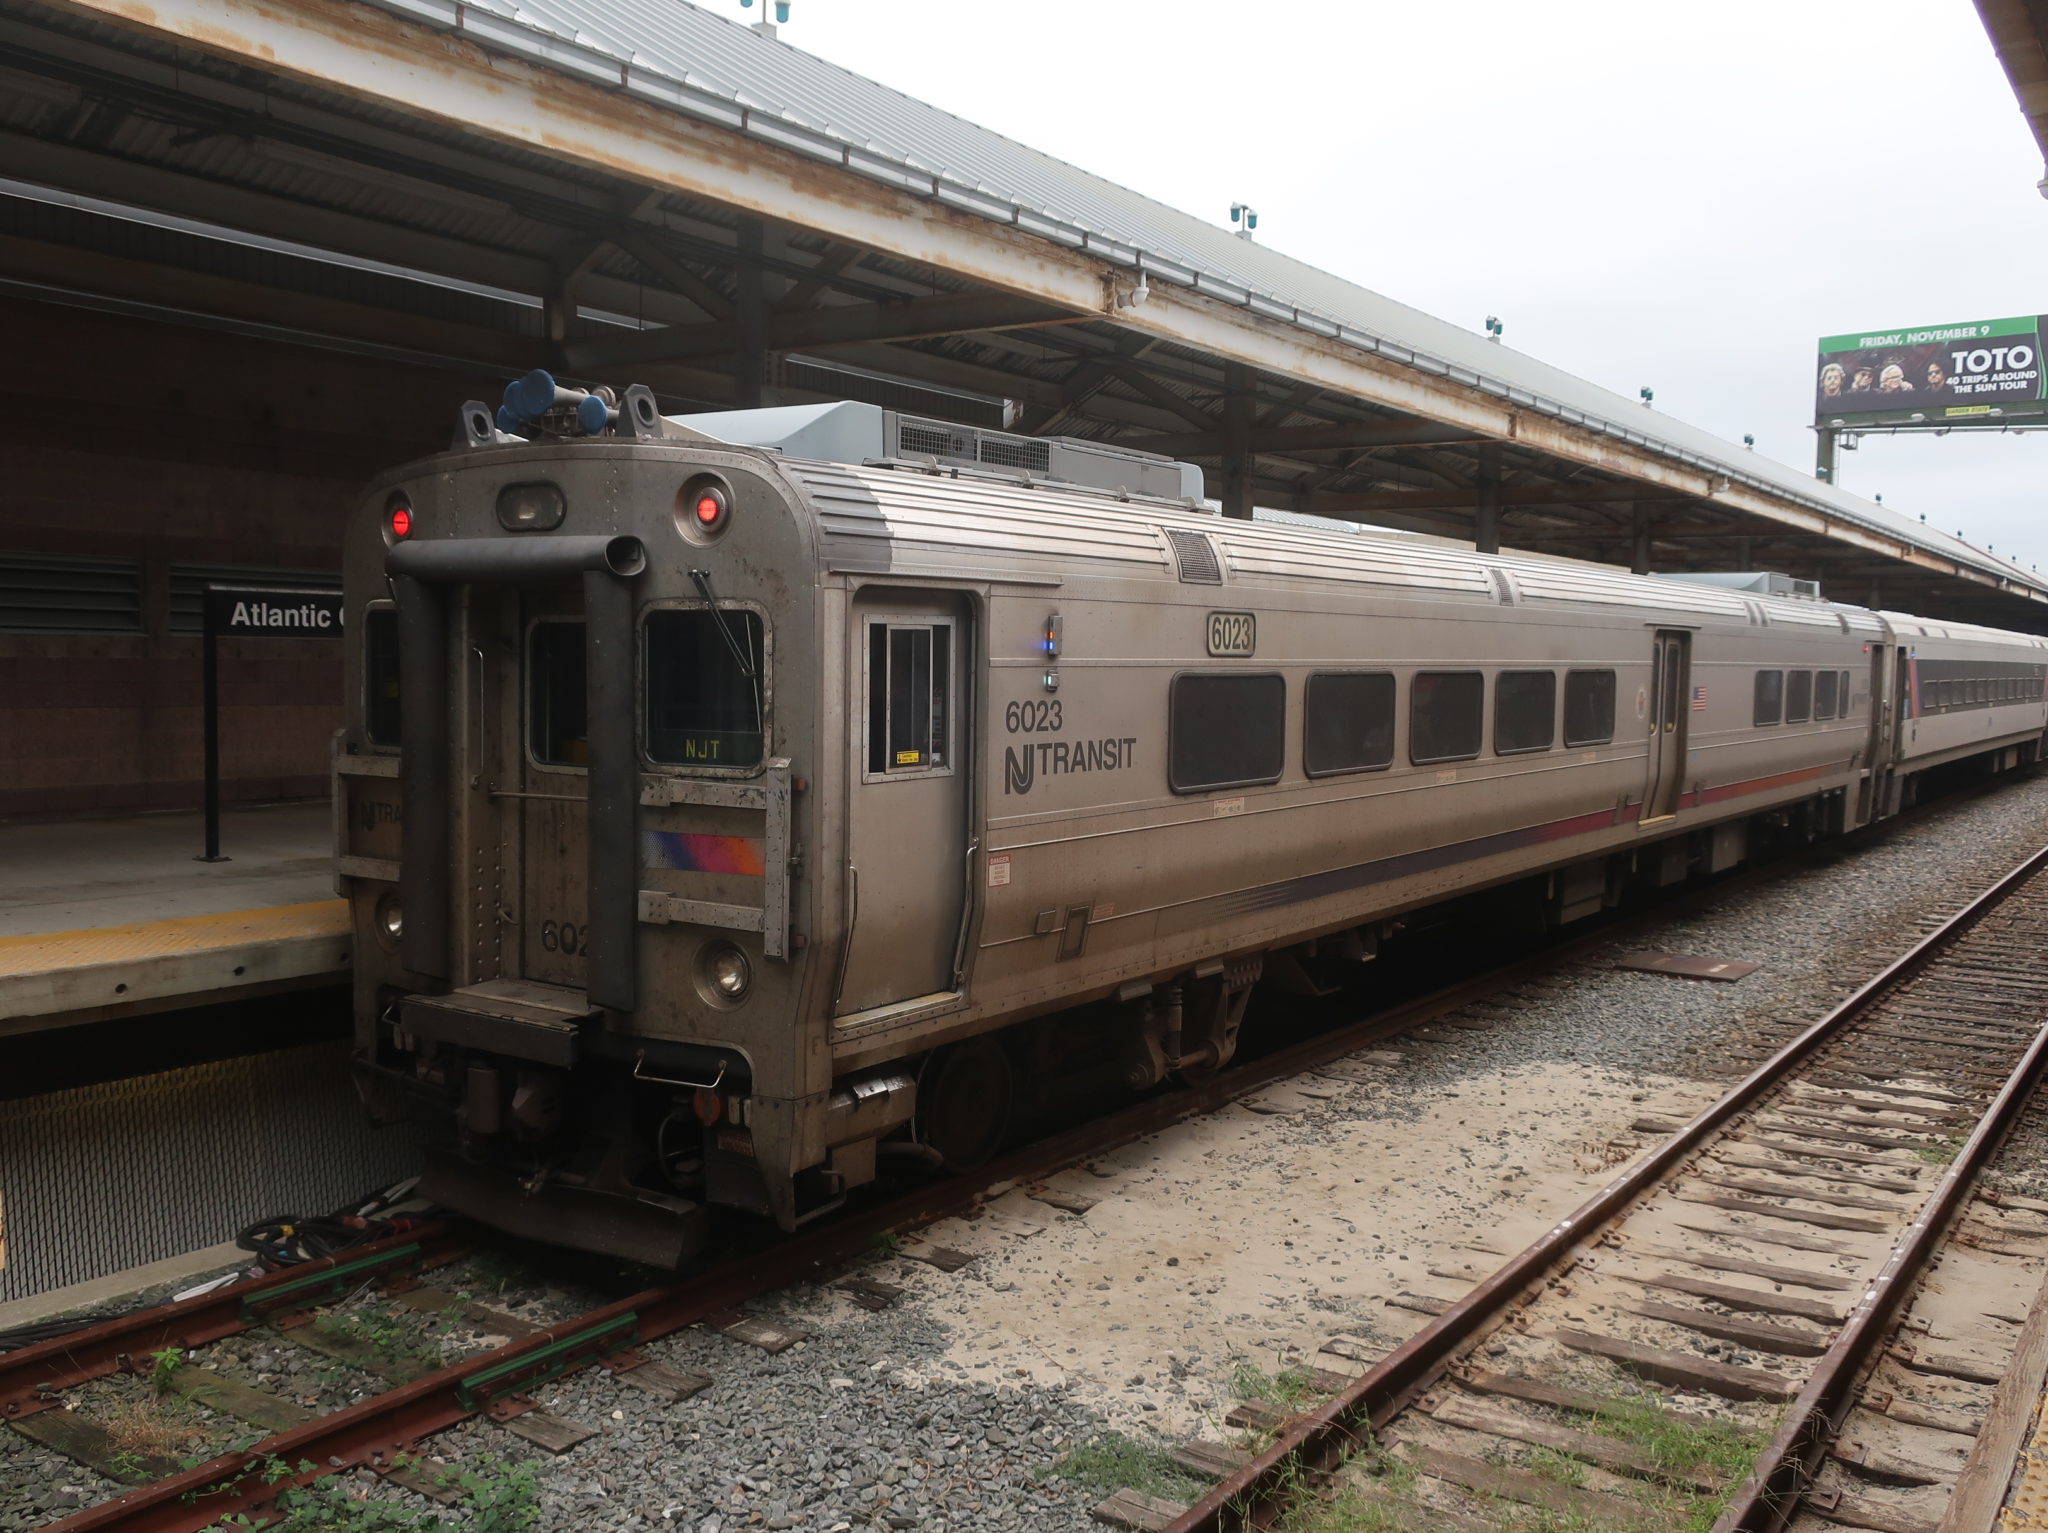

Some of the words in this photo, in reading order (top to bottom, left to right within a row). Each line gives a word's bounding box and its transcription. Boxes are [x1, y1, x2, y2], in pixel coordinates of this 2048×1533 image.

[1859, 334, 1903, 347] FRIDAY,
[1907, 326, 1977, 343] NOVEMBER
[1980, 325, 1990, 336] 9
[1951, 345, 2034, 374] TOTO
[1946, 376, 1960, 385] 40
[1961, 374, 1989, 384] TRIPS
[1991, 370, 2037, 382] AROUND
[1954, 384, 1973, 394] THE
[1974, 382, 1997, 393] SUN
[1999, 380, 2028, 391] TOUR
[230, 601, 332, 628] Atlantic
[1211, 616, 1251, 651] 6023
[1005, 699, 1063, 734] 6023
[685, 739, 720, 760] NJT
[1037, 737, 1137, 776] TRANSIT
